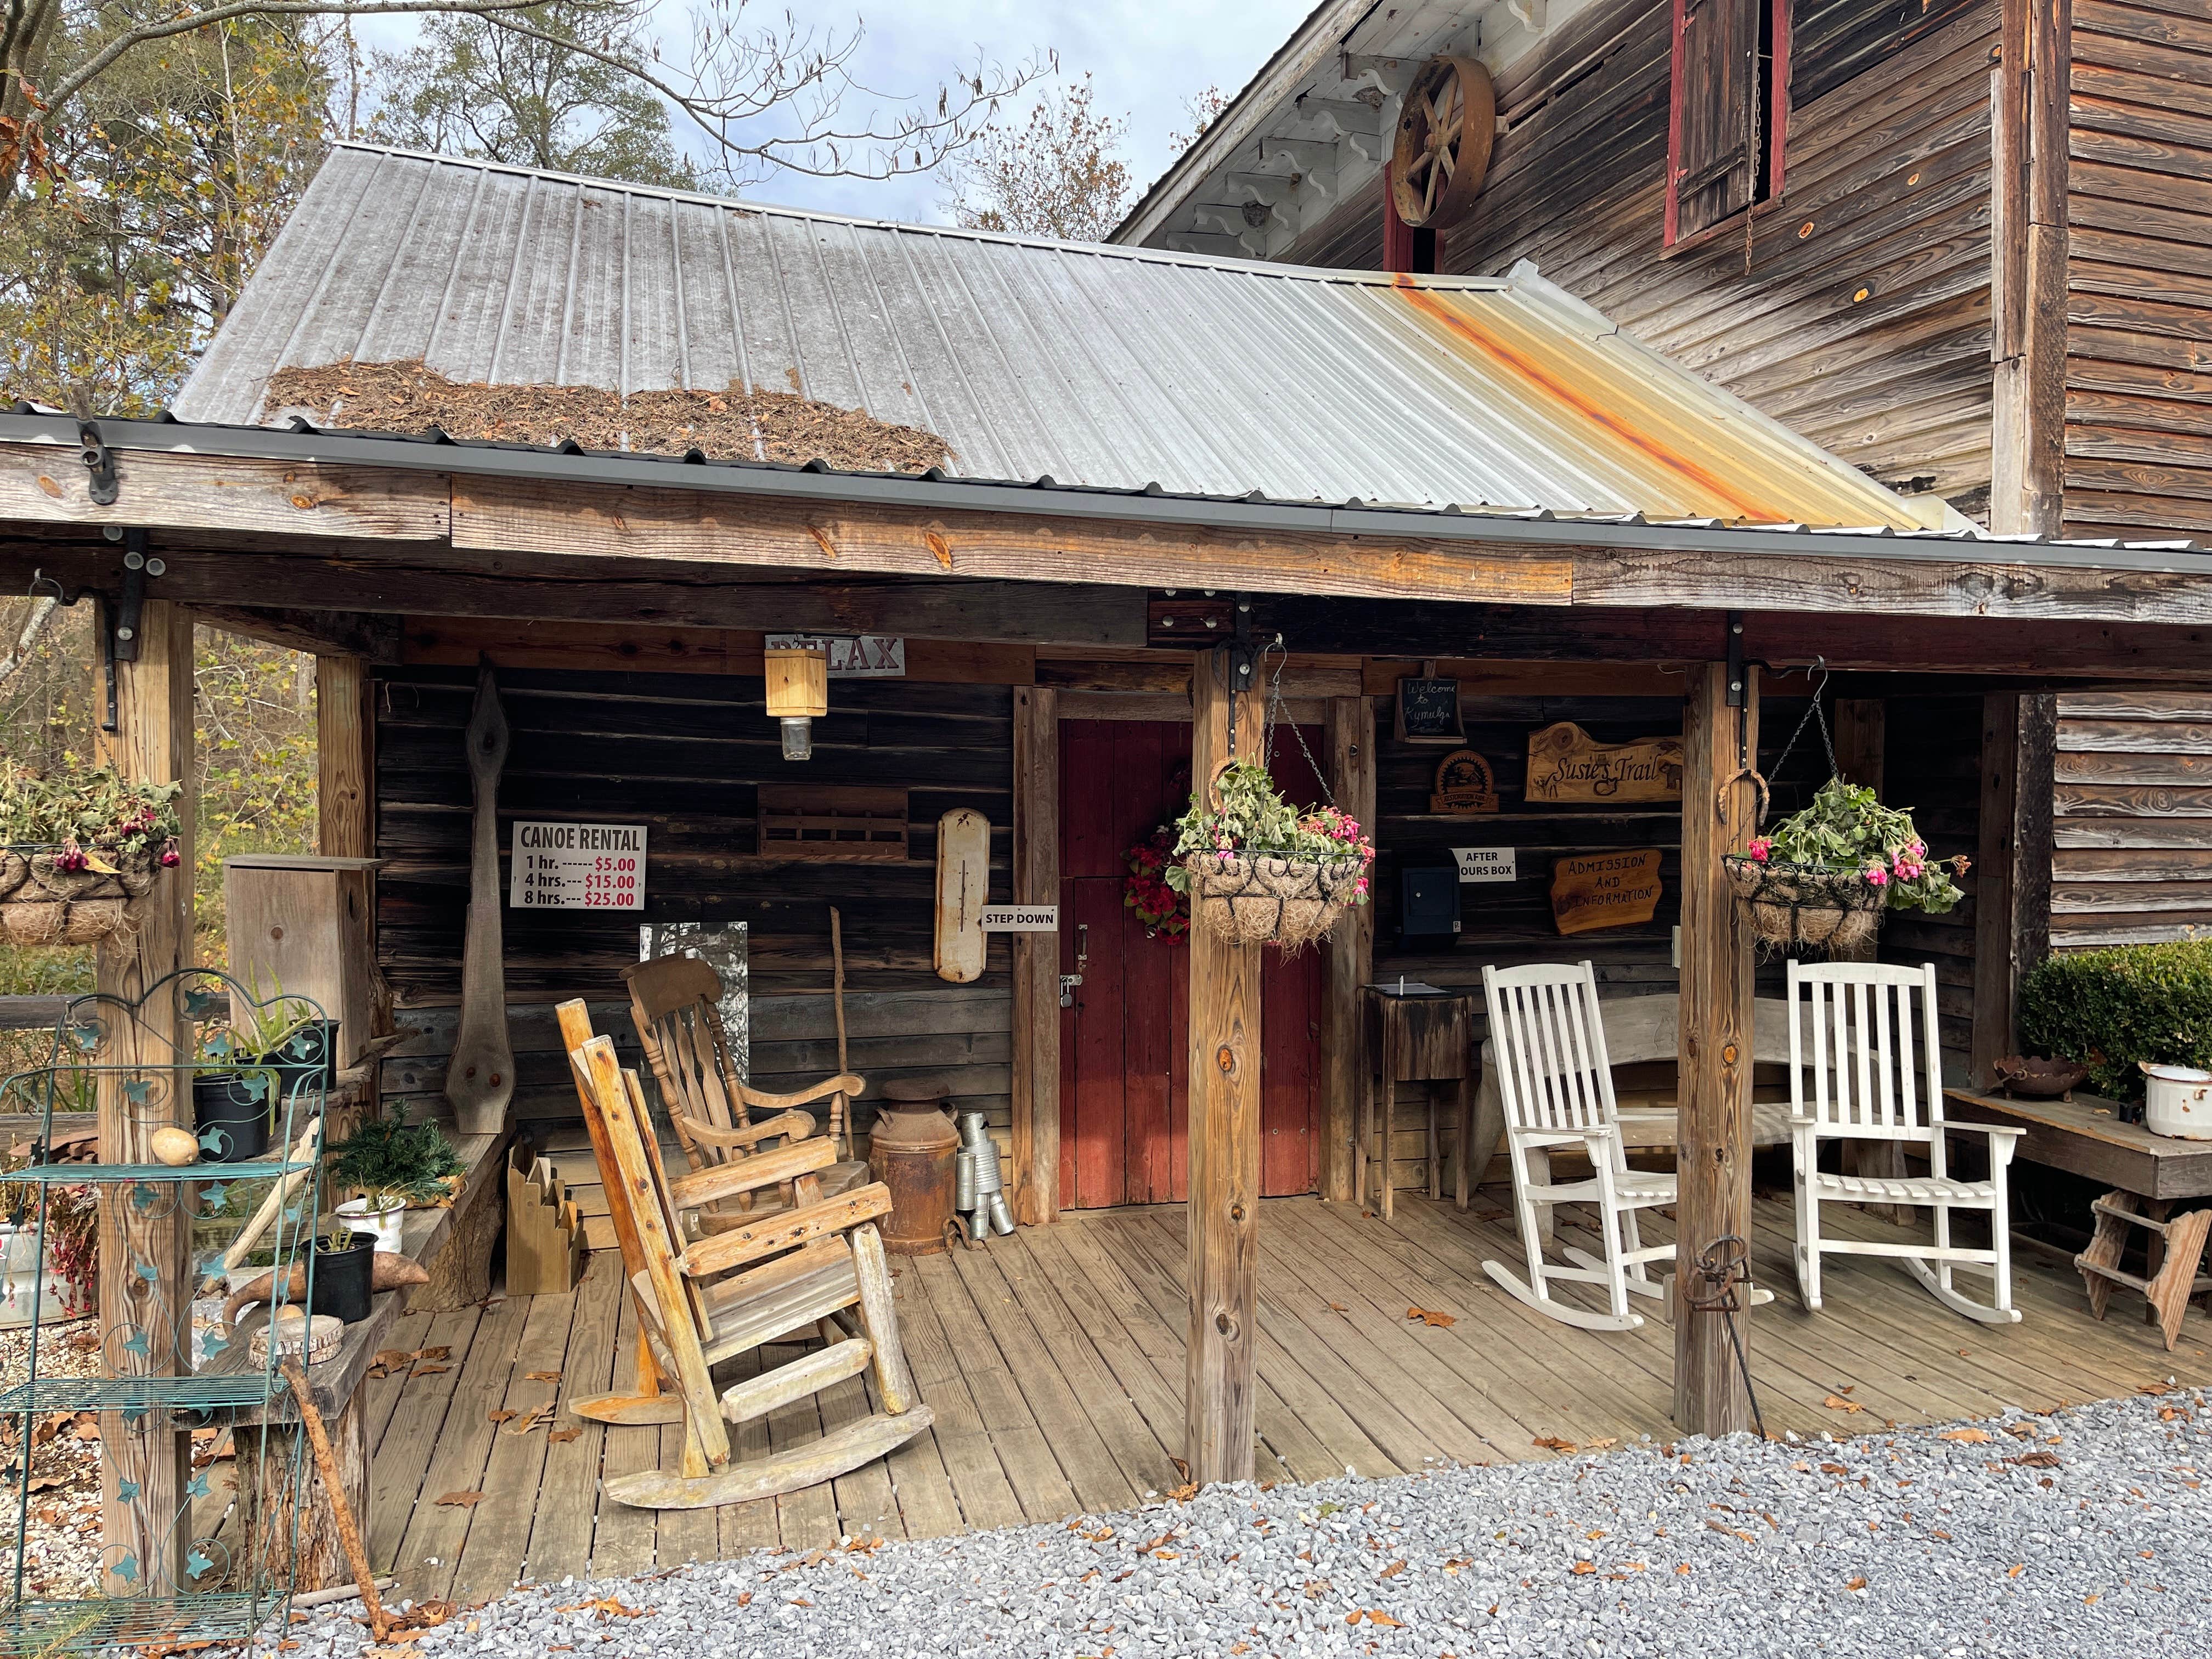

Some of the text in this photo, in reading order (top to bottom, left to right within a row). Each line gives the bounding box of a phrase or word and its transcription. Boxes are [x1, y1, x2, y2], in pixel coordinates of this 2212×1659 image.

[771, 639, 899, 670] LAX
[1408, 681, 1455, 694] Welcome
[1414, 694, 1429, 704] to
[1404, 707, 1450, 728] Kymulga
[1615, 753, 1662, 781] Trail
[521, 826, 640, 851] CANOE RENTAL
[526, 855, 635, 872] 1 hr. $5.00
[1466, 852, 1498, 861] AFTER
[1568, 853, 1647, 874] ADMISSION
[1460, 866, 1512, 876] OURS BOX
[525, 872, 635, 889] 4 hrs. $15.00
[1594, 876, 1620, 889] AND
[524, 890, 634, 906] 8 hrs. $25.00
[1571, 885, 1654, 909] INFORMATION
[986, 913, 1054, 924] STEP DOWN
